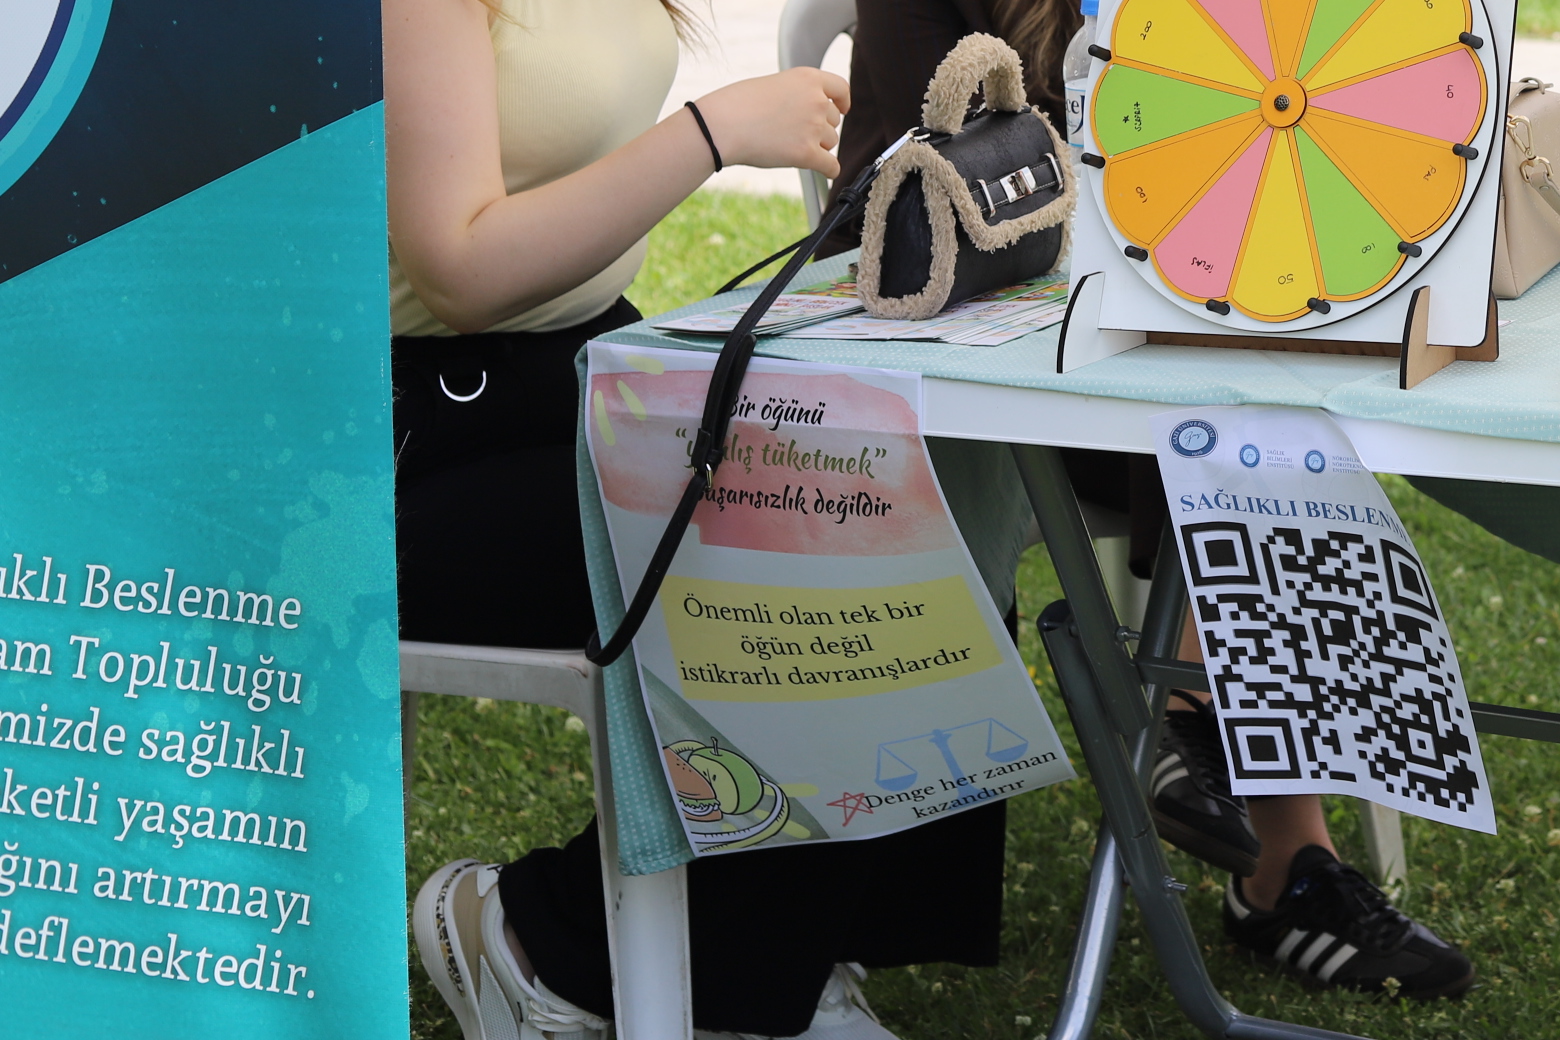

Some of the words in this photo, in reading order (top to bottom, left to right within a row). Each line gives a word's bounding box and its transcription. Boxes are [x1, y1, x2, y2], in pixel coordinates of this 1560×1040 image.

[1140, 20, 1153, 40] 200
[1277, 273, 1294, 285] 50
[761, 397, 826, 431] öğünü
[814, 488, 893, 525] değildir
[1179, 487, 1298, 517] SAĞLIKLI
[80, 564, 302, 630] Beslenme
[683, 592, 774, 626] Önemli
[778, 604, 832, 627] olan
[839, 603, 881, 625] tek
[887, 600, 926, 621] bir
[680, 662, 779, 687] istikrarlı
[787, 643, 973, 687] davranışlardır
[740, 635, 801, 661] öğün
[809, 632, 876, 659] değil
[69, 635, 303, 713] Topluluğu
[139, 720, 306, 779] sağlıklı
[864, 785, 936, 810] Denge
[939, 772, 979, 792] her
[983, 750, 1058, 780] zaman
[911, 779, 1026, 819] kazandırır
[114, 794, 309, 853] yaşamın
[93, 865, 312, 936] artırmayı
